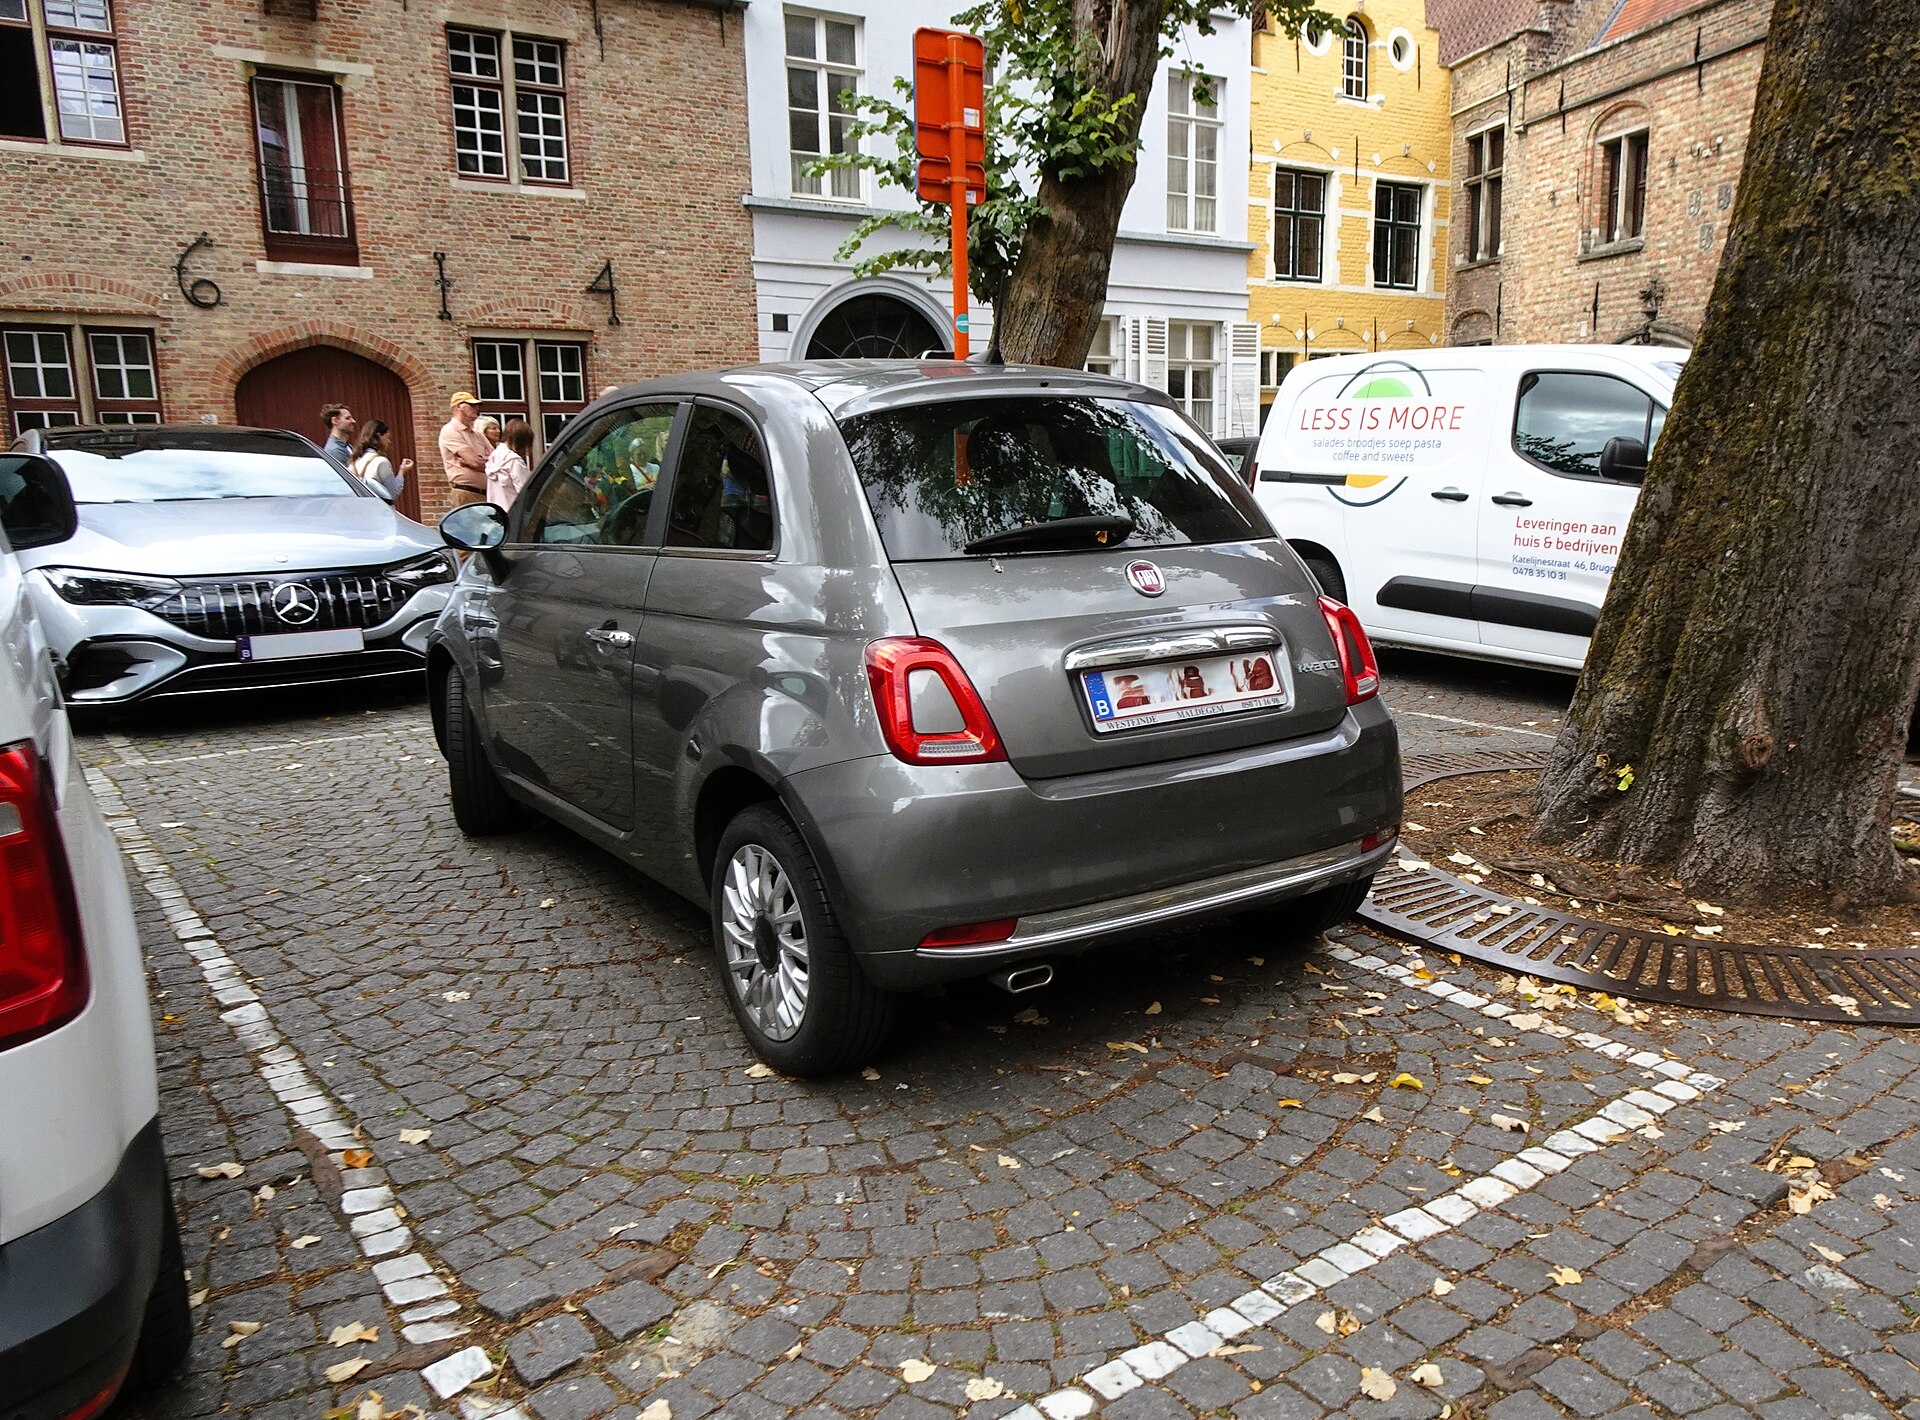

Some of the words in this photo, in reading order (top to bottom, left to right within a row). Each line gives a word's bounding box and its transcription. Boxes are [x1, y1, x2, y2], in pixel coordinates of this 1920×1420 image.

[1300, 408, 1352, 431] LESS
[1359, 407, 1382, 430] IS
[1388, 406, 1465, 431] MORE
[1312, 437, 1345, 448] salades
[1347, 437, 1386, 449] broodjes
[1388, 439, 1411, 450] soep
[1414, 440, 1442, 451] pasta
[1333, 450, 1359, 462] coffee
[1361, 451, 1379, 462] and
[1381, 452, 1415, 463] sweets
[1516, 515, 1587, 535] Leveringen
[1591, 524, 1617, 536] aan
[1513, 534, 1540, 548] huis
[1543, 536, 1553, 549] &
[1555, 537, 1618, 556] bedrijven
[1512, 554, 1571, 568] Katelijnestraat
[1574, 560, 1587, 571] 46,
[1134, 569, 1160, 587] FIAT
[1512, 566, 1534, 577] 0478
[1536, 569, 1546, 578] 35
[1547, 570, 1557, 579] 10
[1558, 571, 1567, 580] 31
[1095, 699, 1110, 716] B
[1176, 704, 1225, 719] MALDEGEM
